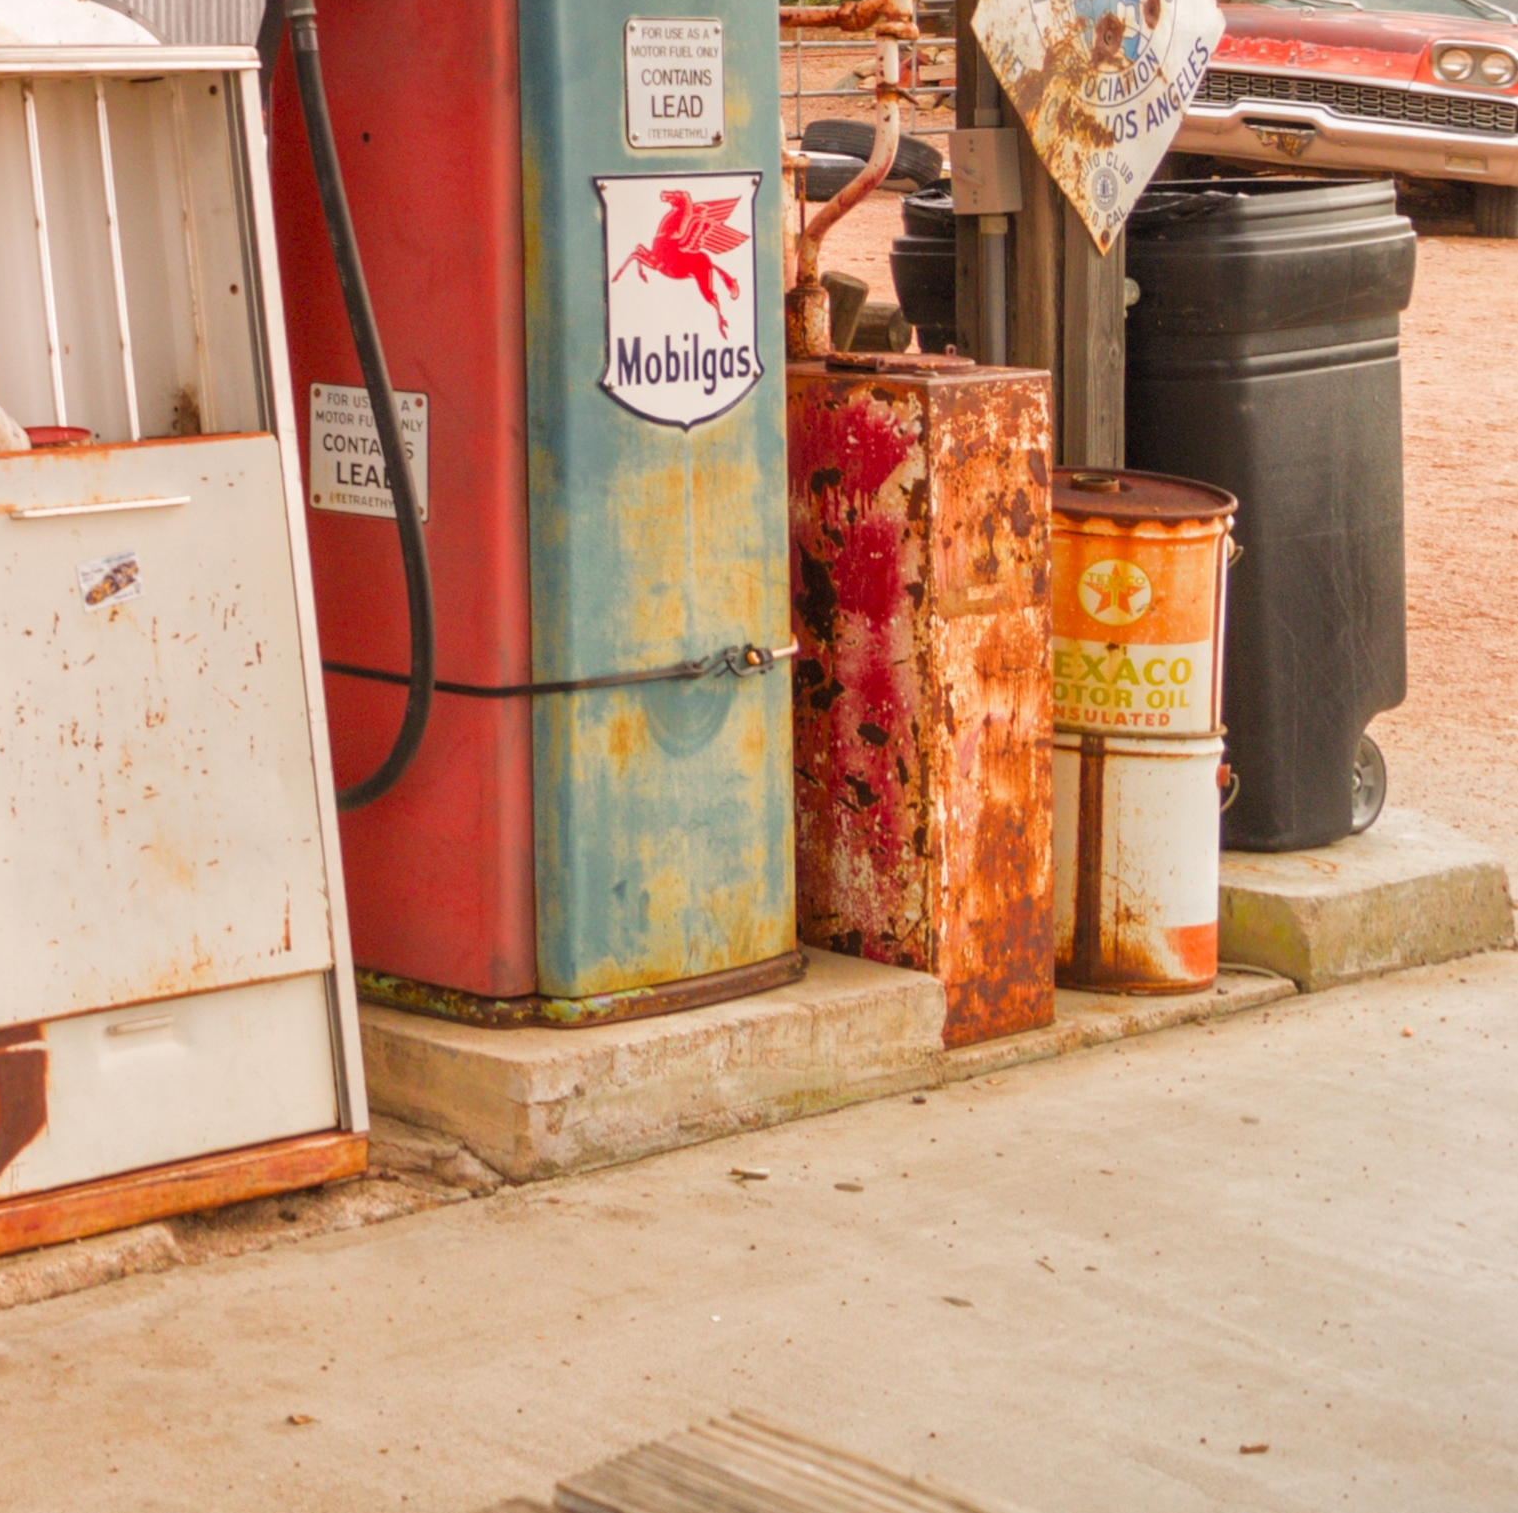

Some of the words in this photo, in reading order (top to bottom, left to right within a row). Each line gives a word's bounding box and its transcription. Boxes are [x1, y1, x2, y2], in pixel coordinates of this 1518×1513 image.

[641, 27, 662, 40] FOR
[664, 27, 685, 40] USE
[687, 27, 701, 40] AS
[703, 27, 710, 40] A
[631, 46, 667, 59] MOTOR
[669, 46, 694, 59] FUEL
[696, 46, 720, 59] ONLY
[641, 68, 713, 87] CONTAINS
[1146, 37, 1209, 134] ANGELES
[651, 95, 704, 119] LEAD
[647, 127, 709, 141] (TETRAETHYL)
[1106, 151, 1134, 185] CLUB
[617, 332, 751, 396] Mobilgas
[327, 391, 349, 406] FOR
[353, 395, 372, 409] US
[401, 399, 410, 413] A
[315, 410, 355, 426] MOTOR
[359, 414, 374, 428] FU
[400, 419, 424, 433] NLY
[323, 433, 415, 460] CONTAS
[1087, 570, 1147, 587] TEXACO
[1053, 649, 1192, 687] EXACO
[1053, 682, 1132, 709] OTOR
[1146, 686, 1192, 710] OIL
[1053, 706, 1171, 727] NSULATED
